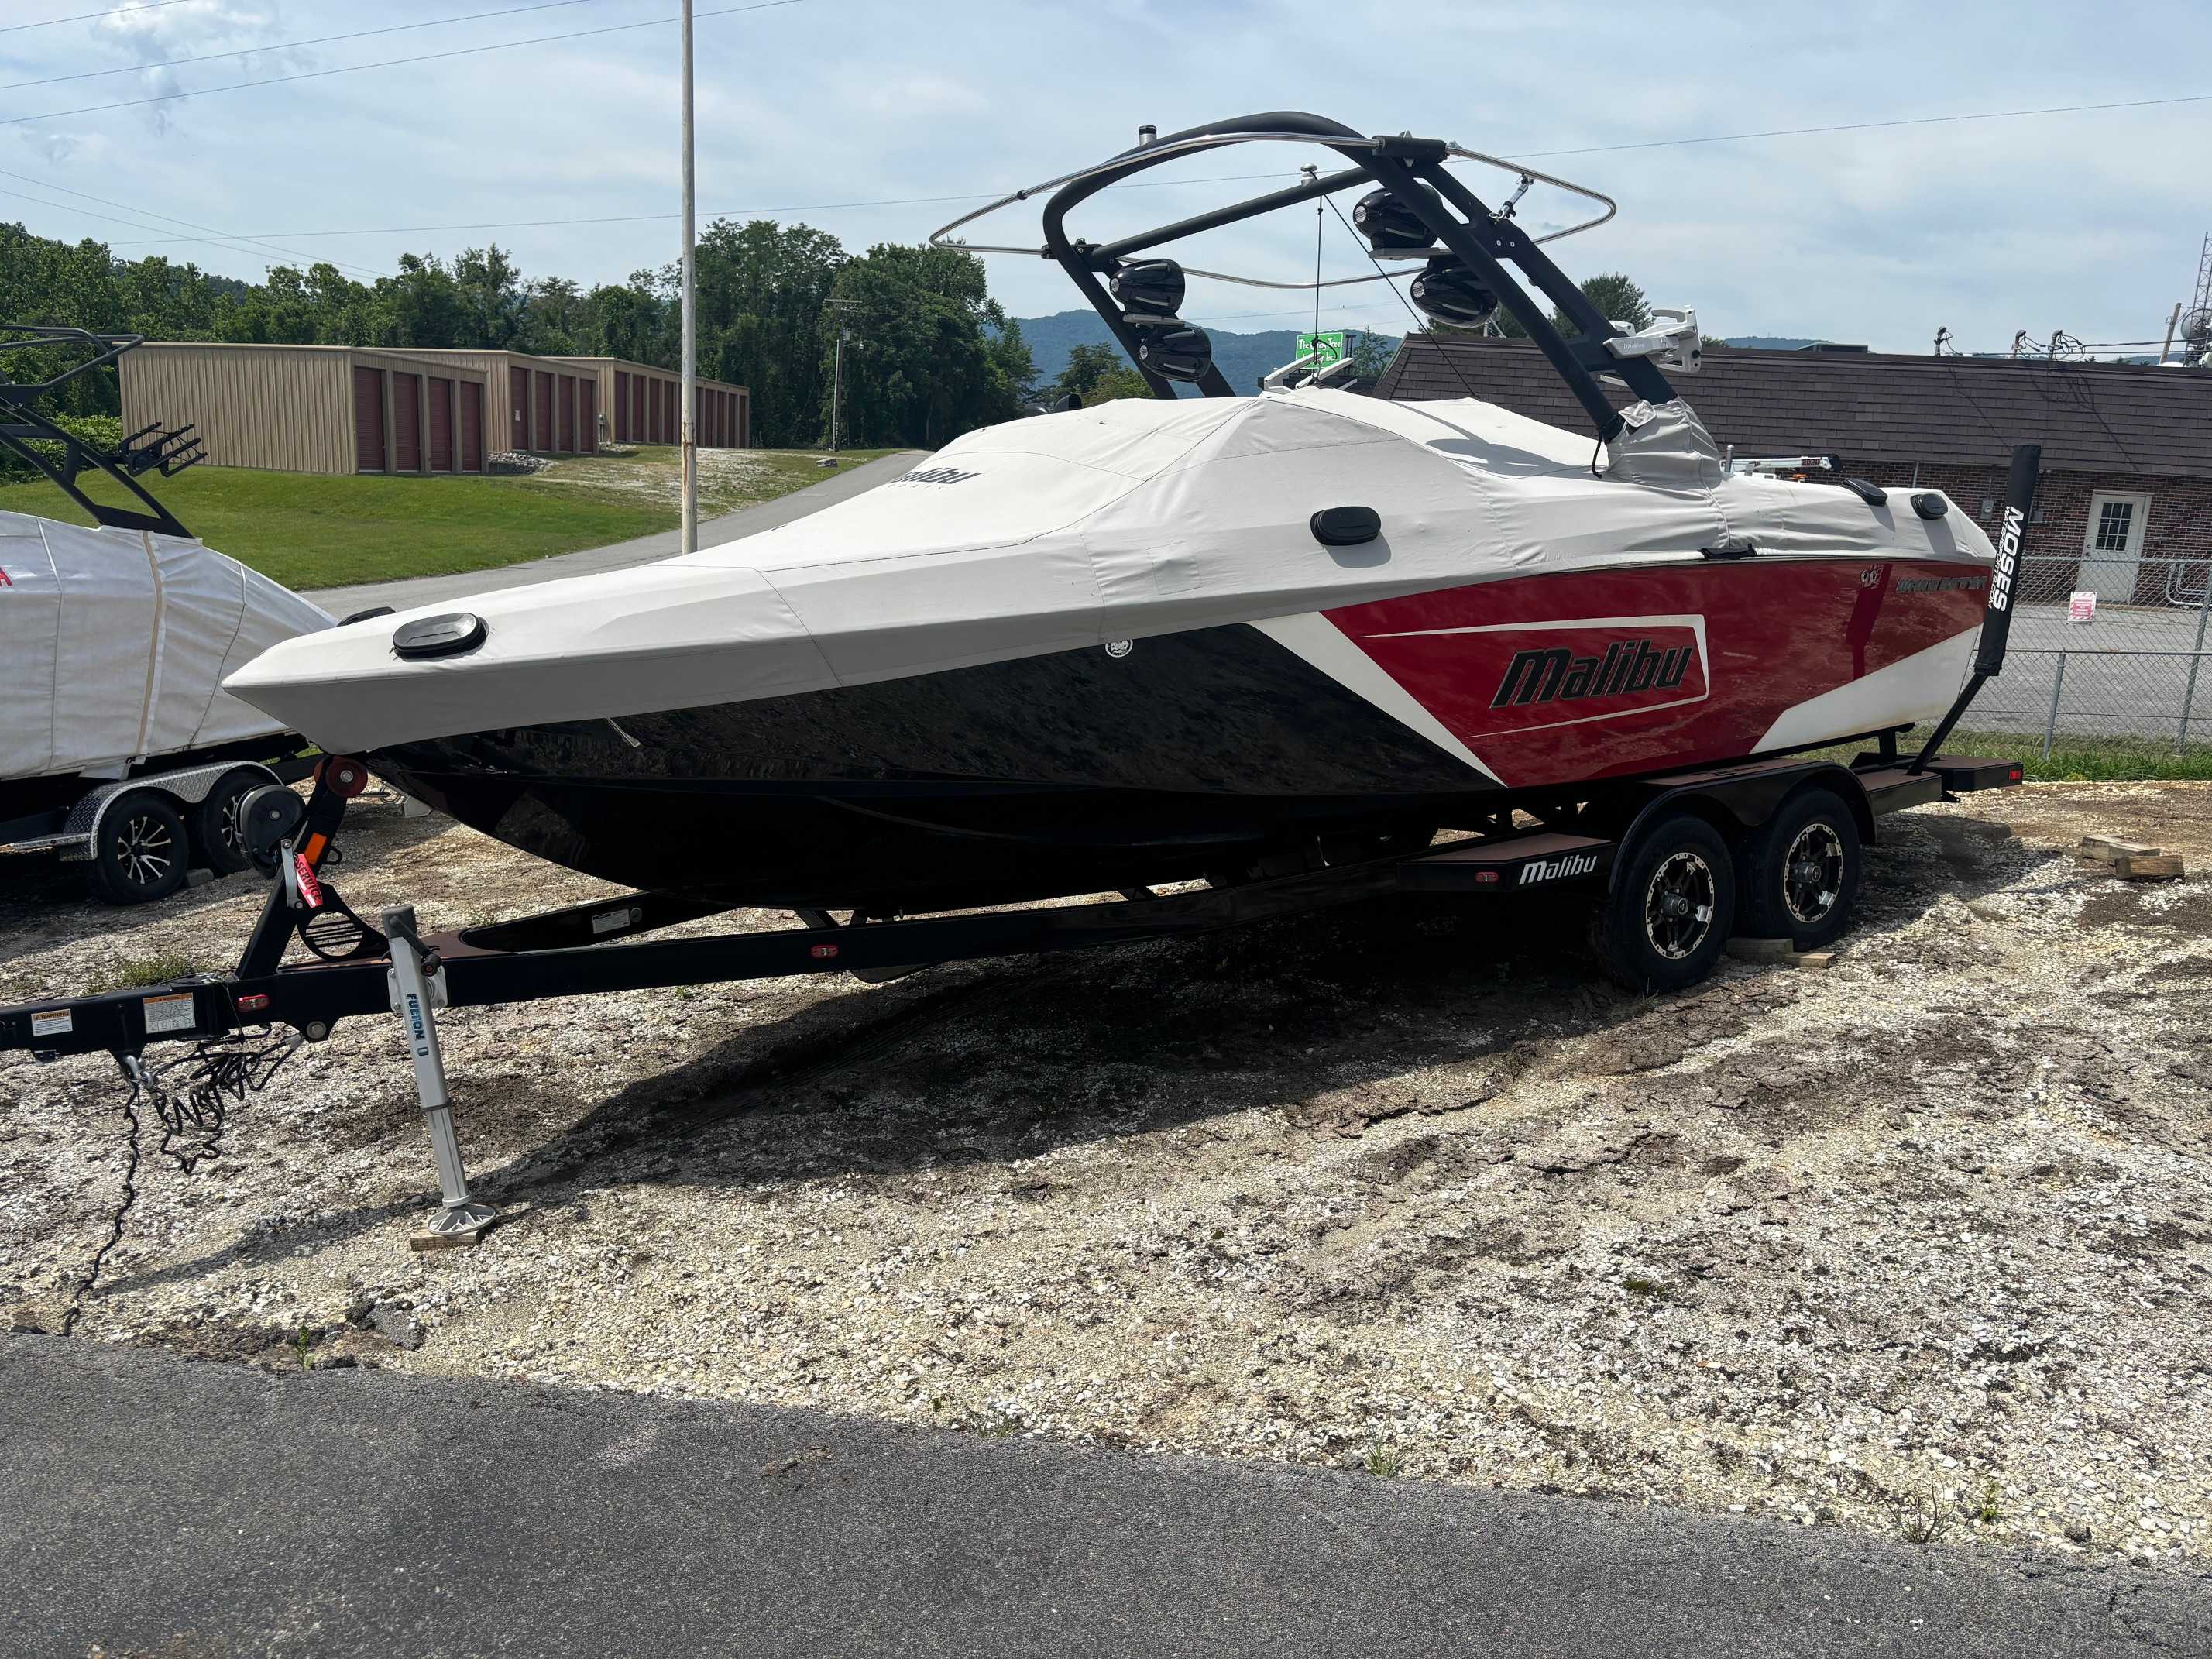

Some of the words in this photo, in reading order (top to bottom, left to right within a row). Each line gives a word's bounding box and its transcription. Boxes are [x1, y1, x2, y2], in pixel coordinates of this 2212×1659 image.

[1299, 338, 1310, 349] The
[1993, 505, 2025, 612] MOSES
[1489, 638, 1695, 710] Malibu
[1519, 854, 1598, 885] Malibu
[407, 993, 426, 1040] FULTON
